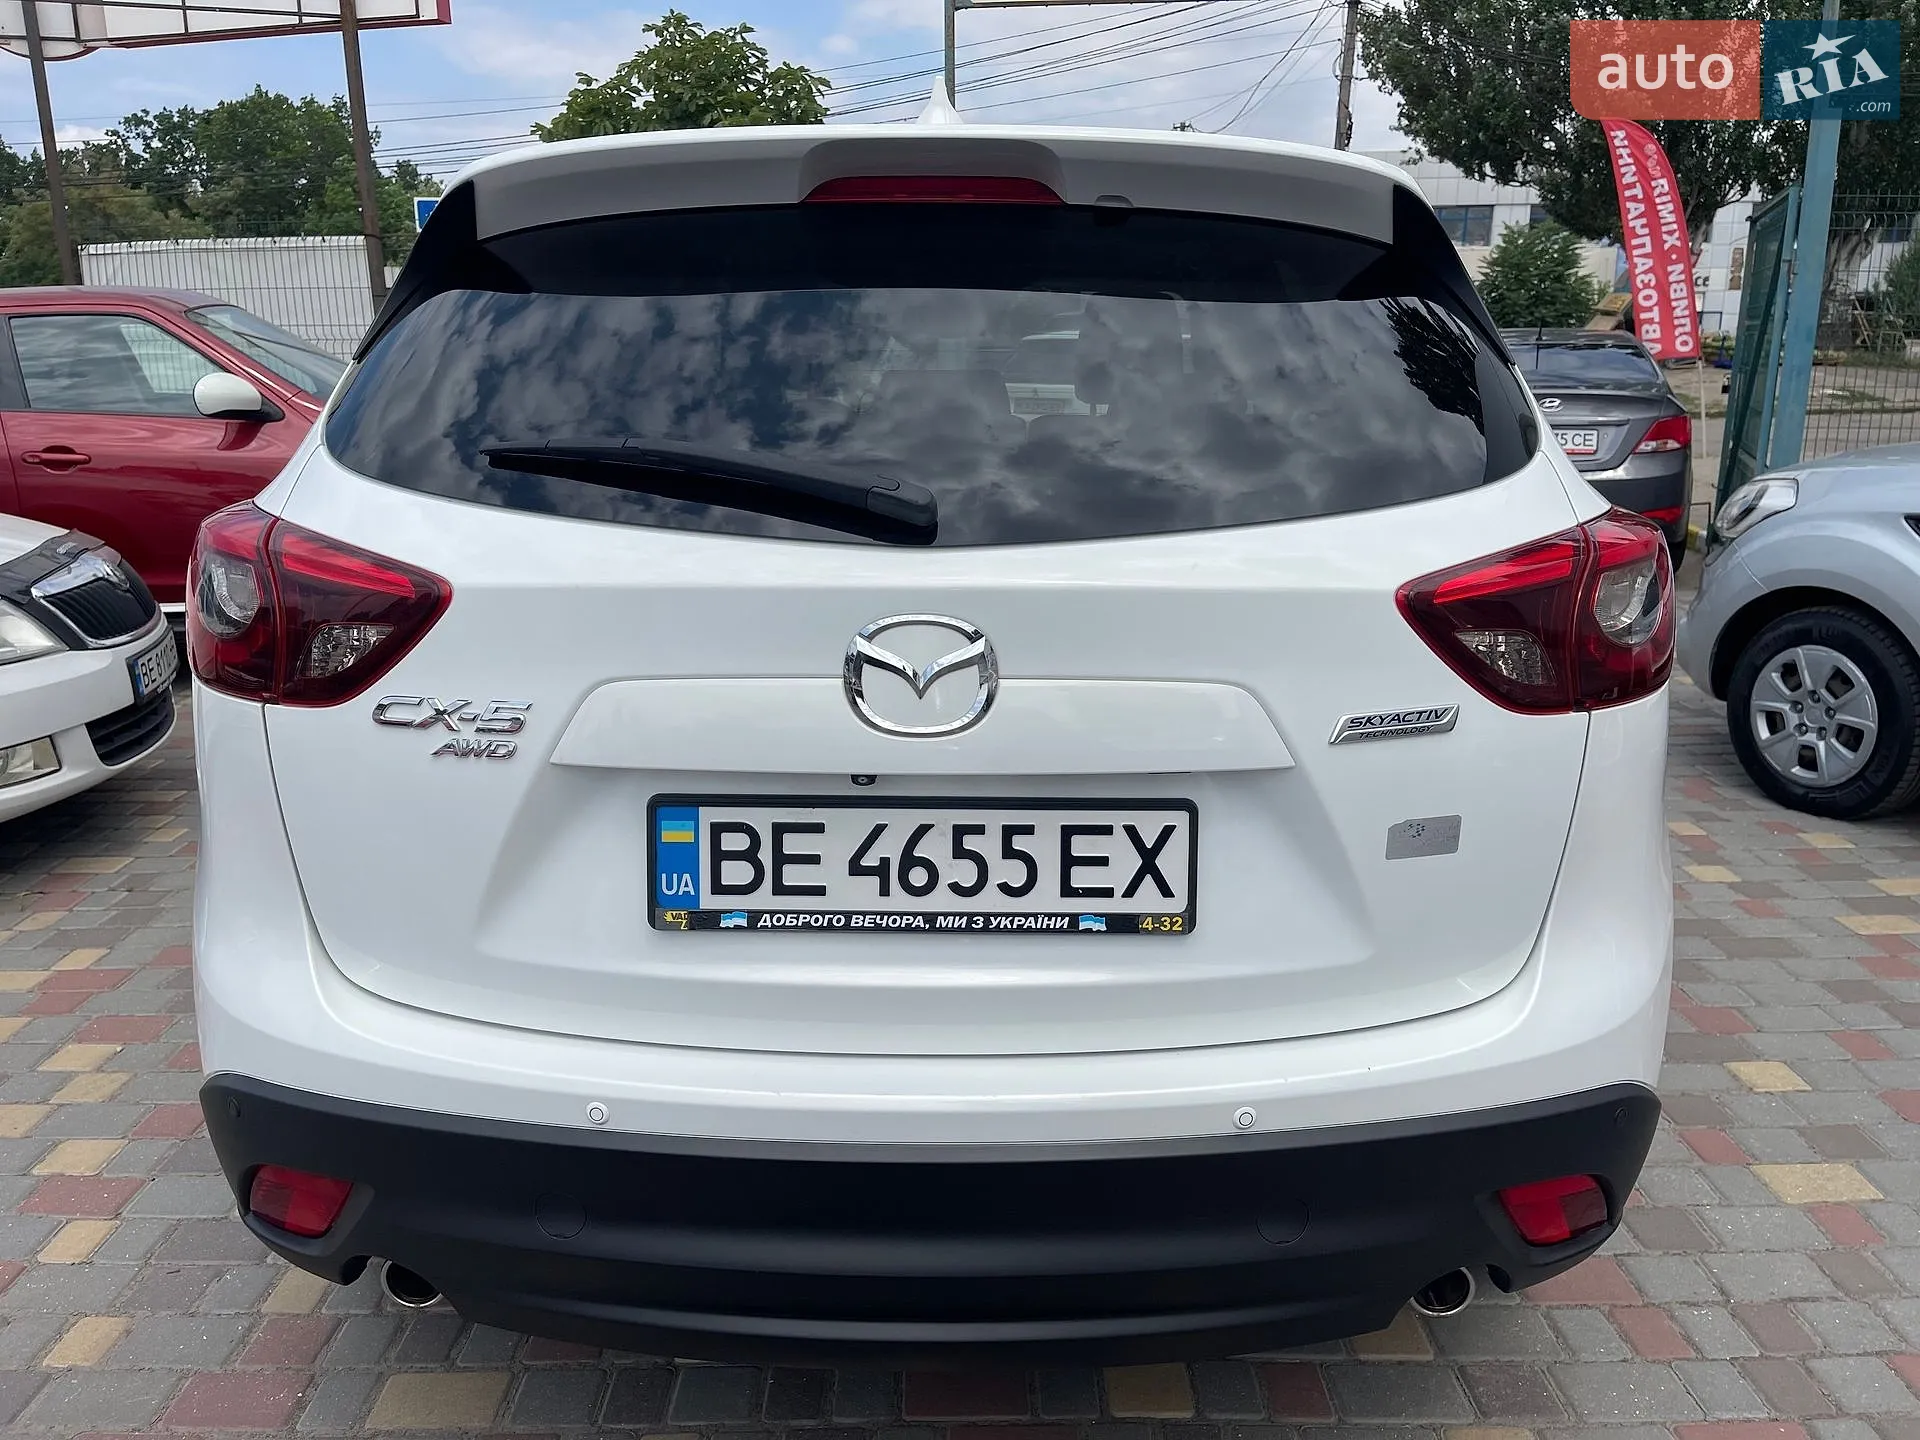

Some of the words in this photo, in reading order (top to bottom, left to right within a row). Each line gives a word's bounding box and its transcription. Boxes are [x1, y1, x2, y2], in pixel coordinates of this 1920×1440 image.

[1571, 432, 1594, 447] CE
[140, 657, 157, 689] BE
[371, 695, 533, 735] CX-5
[1347, 708, 1450, 729] SKYACTIV
[1359, 725, 1434, 739] TECHNOLOGY
[430, 738, 518, 760] AWD
[710, 821, 827, 897] BE
[848, 823, 1038, 898] 4655
[1060, 824, 1177, 898] EX
[661, 873, 695, 895] UA
[757, 913, 846, 928] ДОБРОГО
[850, 914, 930, 930] ВЕЧОРА,
[935, 915, 967, 928] МИ
[971, 916, 984, 929] З
[988, 914, 1070, 929] УКРАЇНИ
